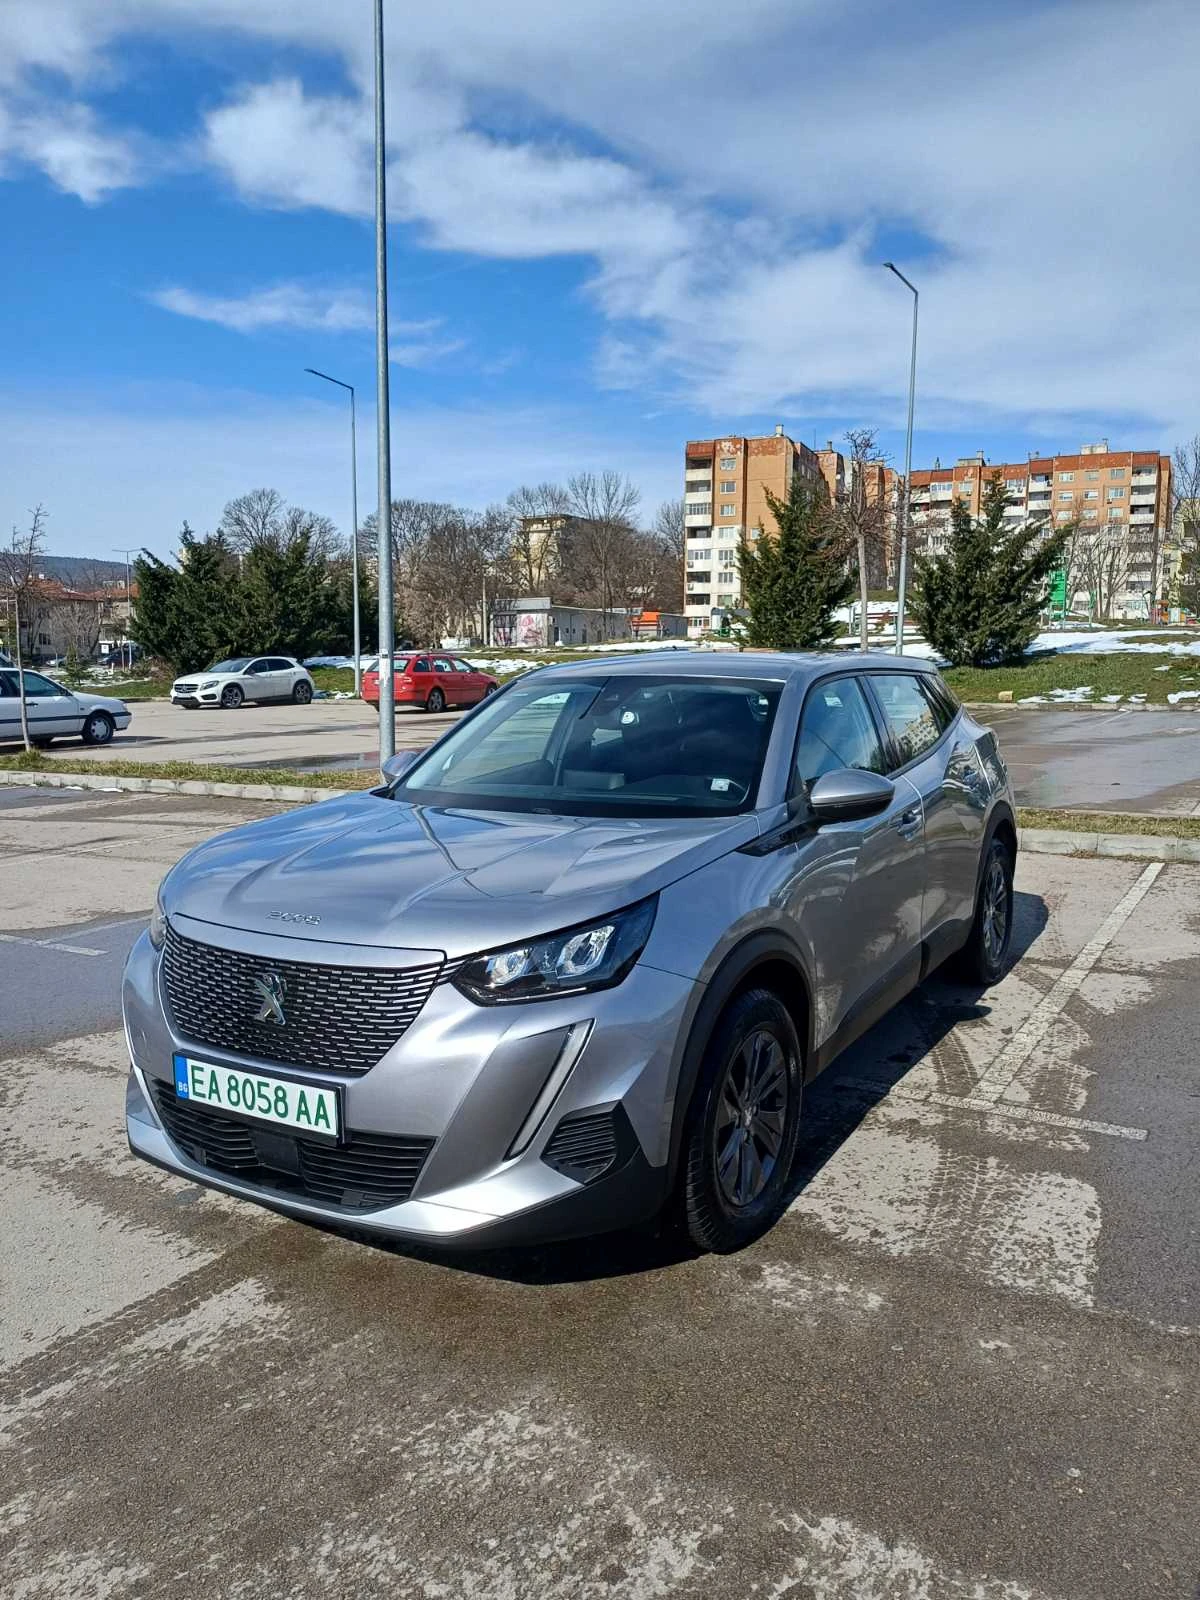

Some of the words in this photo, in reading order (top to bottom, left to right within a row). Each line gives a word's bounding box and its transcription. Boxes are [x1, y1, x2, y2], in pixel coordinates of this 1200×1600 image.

[190, 1064, 222, 1103] EA
[227, 1074, 289, 1119] 8058
[295, 1089, 331, 1129] AA
